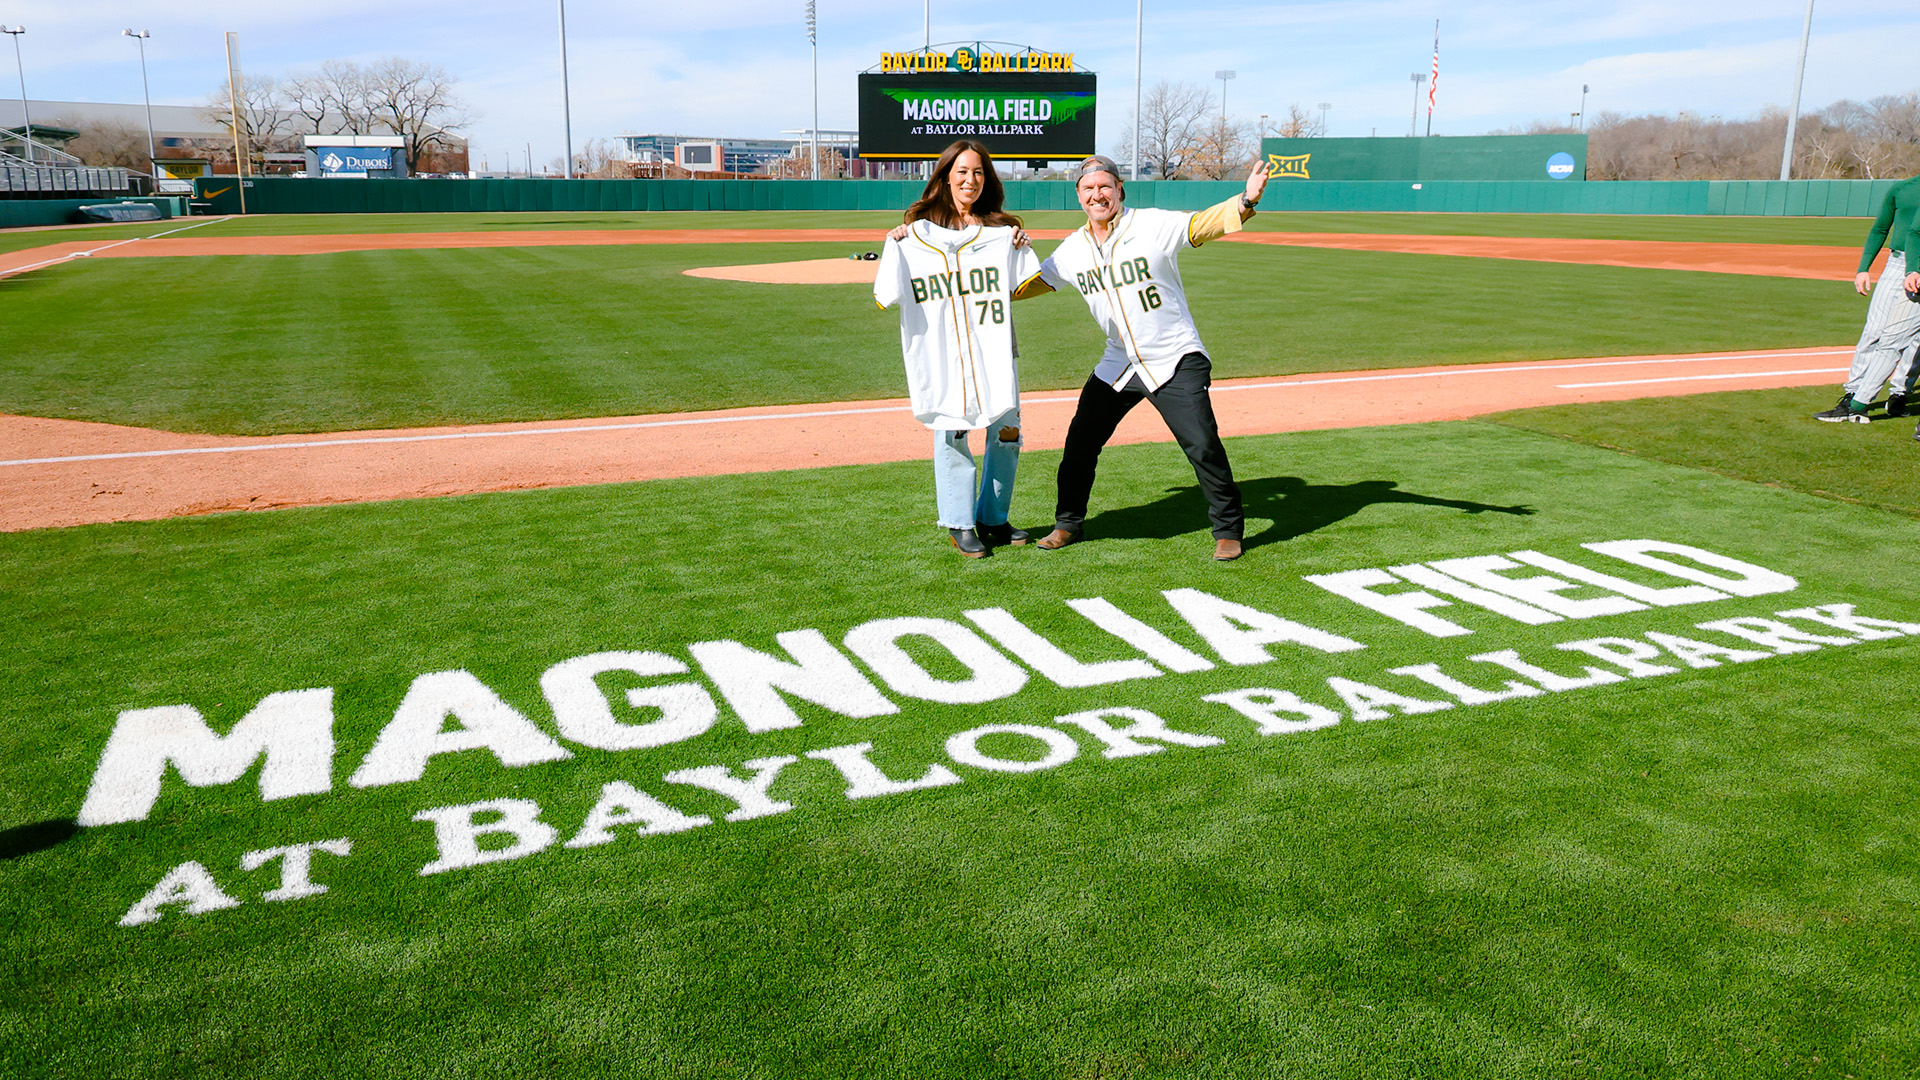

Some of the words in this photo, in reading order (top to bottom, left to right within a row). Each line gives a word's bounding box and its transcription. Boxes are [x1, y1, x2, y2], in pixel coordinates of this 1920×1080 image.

[881, 52, 947, 72] BAYLOR
[980, 52, 1075, 72] BALLPARK
[903, 99, 999, 121] MAGNOLIA
[1004, 99, 1052, 121] FIELD
[911, 126, 923, 135] AT
[925, 124, 975, 135] BAYLOR
[978, 124, 1043, 135] BALLPARK
[169, 165, 199, 175] BAYLOR
[911, 266, 1001, 304] BAYLOR
[1077, 256, 1152, 296] BAYLOR
[975, 299, 1005, 325] 78
[1138, 285, 1162, 313] 16
[76, 586, 1368, 827] MAGNOLIA
[1305, 537, 1799, 638] FIELD
[117, 837, 353, 928] AT
[411, 705, 1225, 878] BAYLOR
[1203, 602, 1920, 737] BALLPARK
